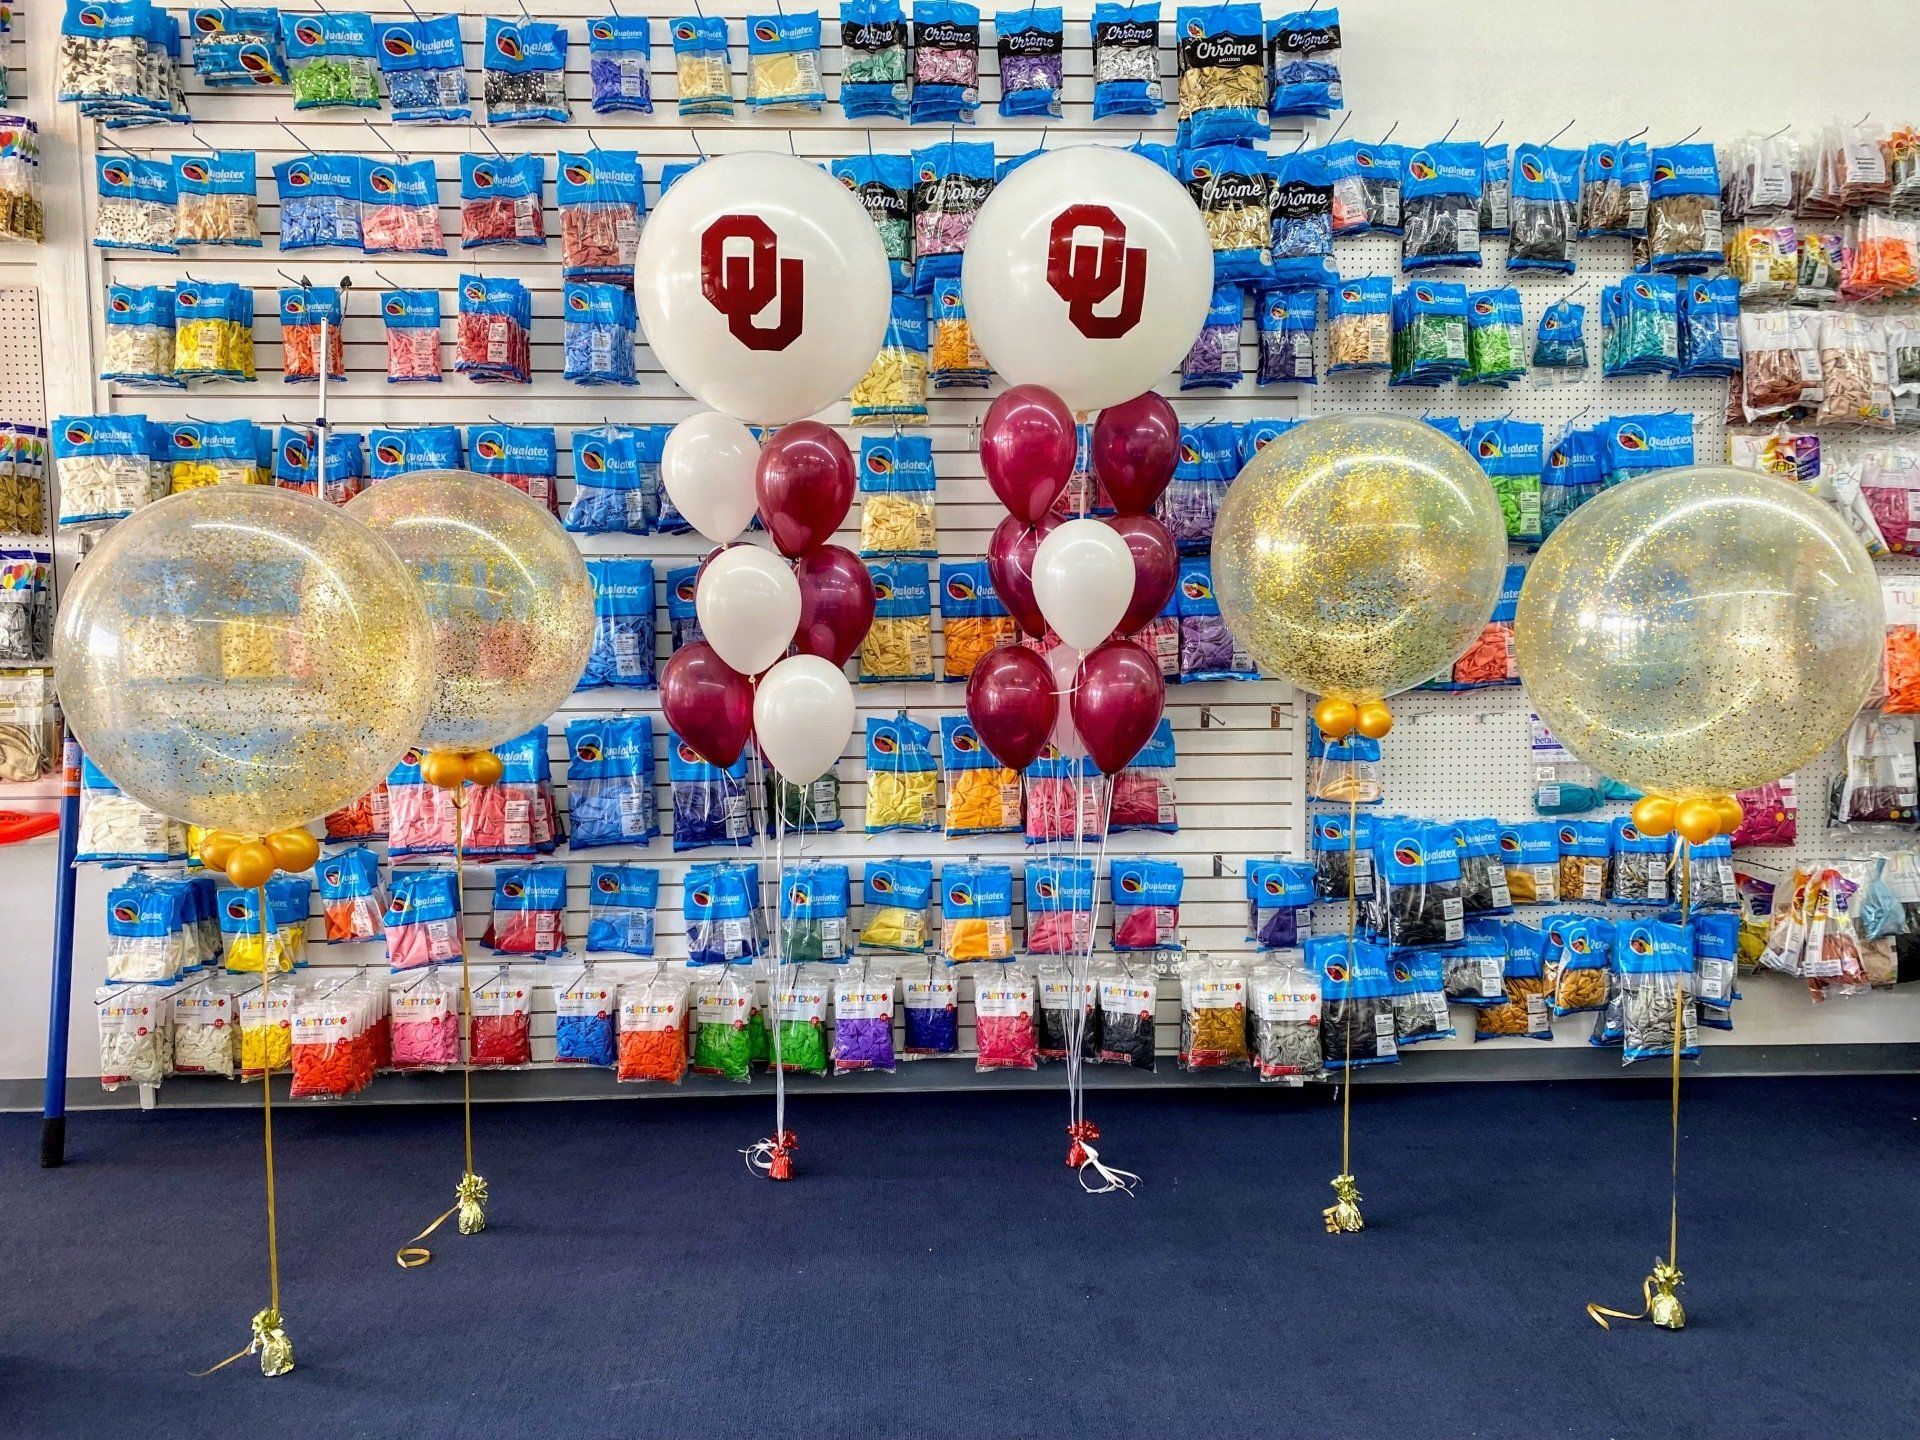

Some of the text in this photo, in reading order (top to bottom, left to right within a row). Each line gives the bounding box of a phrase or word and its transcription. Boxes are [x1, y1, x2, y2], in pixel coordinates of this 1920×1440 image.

[925, 27, 971, 43] Chrome
[1010, 36, 1054, 50] Chrome
[1107, 28, 1153, 43] Chrome
[1199, 43, 1257, 59] Chrome
[926, 184, 986, 204] Chrome
[1202, 182, 1262, 199] Chrome
[1270, 192, 1327, 209] Chrome
[1046, 203, 1148, 338] OU
[701, 214, 804, 351] OU
